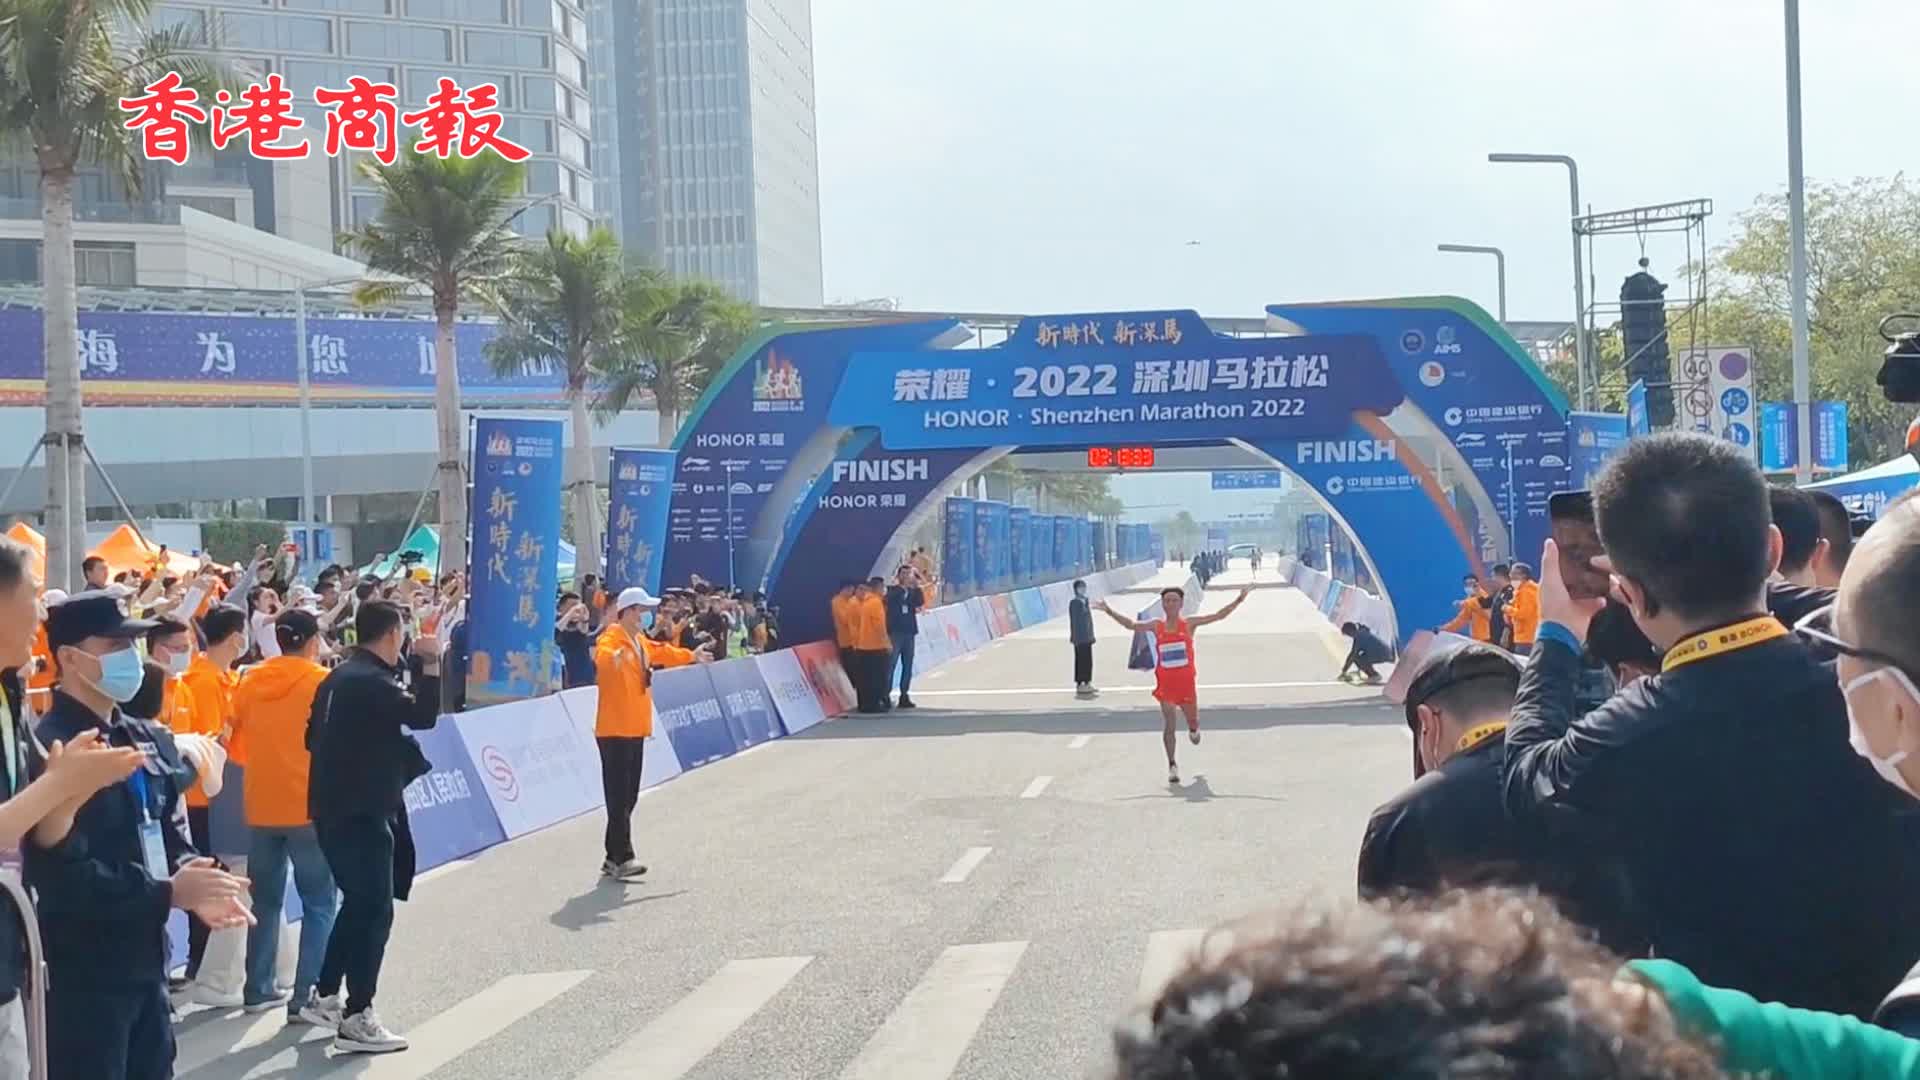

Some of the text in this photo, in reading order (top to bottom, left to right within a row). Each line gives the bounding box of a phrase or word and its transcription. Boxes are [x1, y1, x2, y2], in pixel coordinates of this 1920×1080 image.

[1036, 320, 1104, 348] 新時代
[894, 355, 1329, 401] 荣耀 2022 深圳马拉松
[924, 398, 1305, 428] HONOR Shenzhen Marathon 2022
[697, 433, 756, 447] HONOR
[1297, 439, 1396, 464] FINISH
[832, 458, 929, 483] FINISH
[818, 494, 877, 509] HONOR
